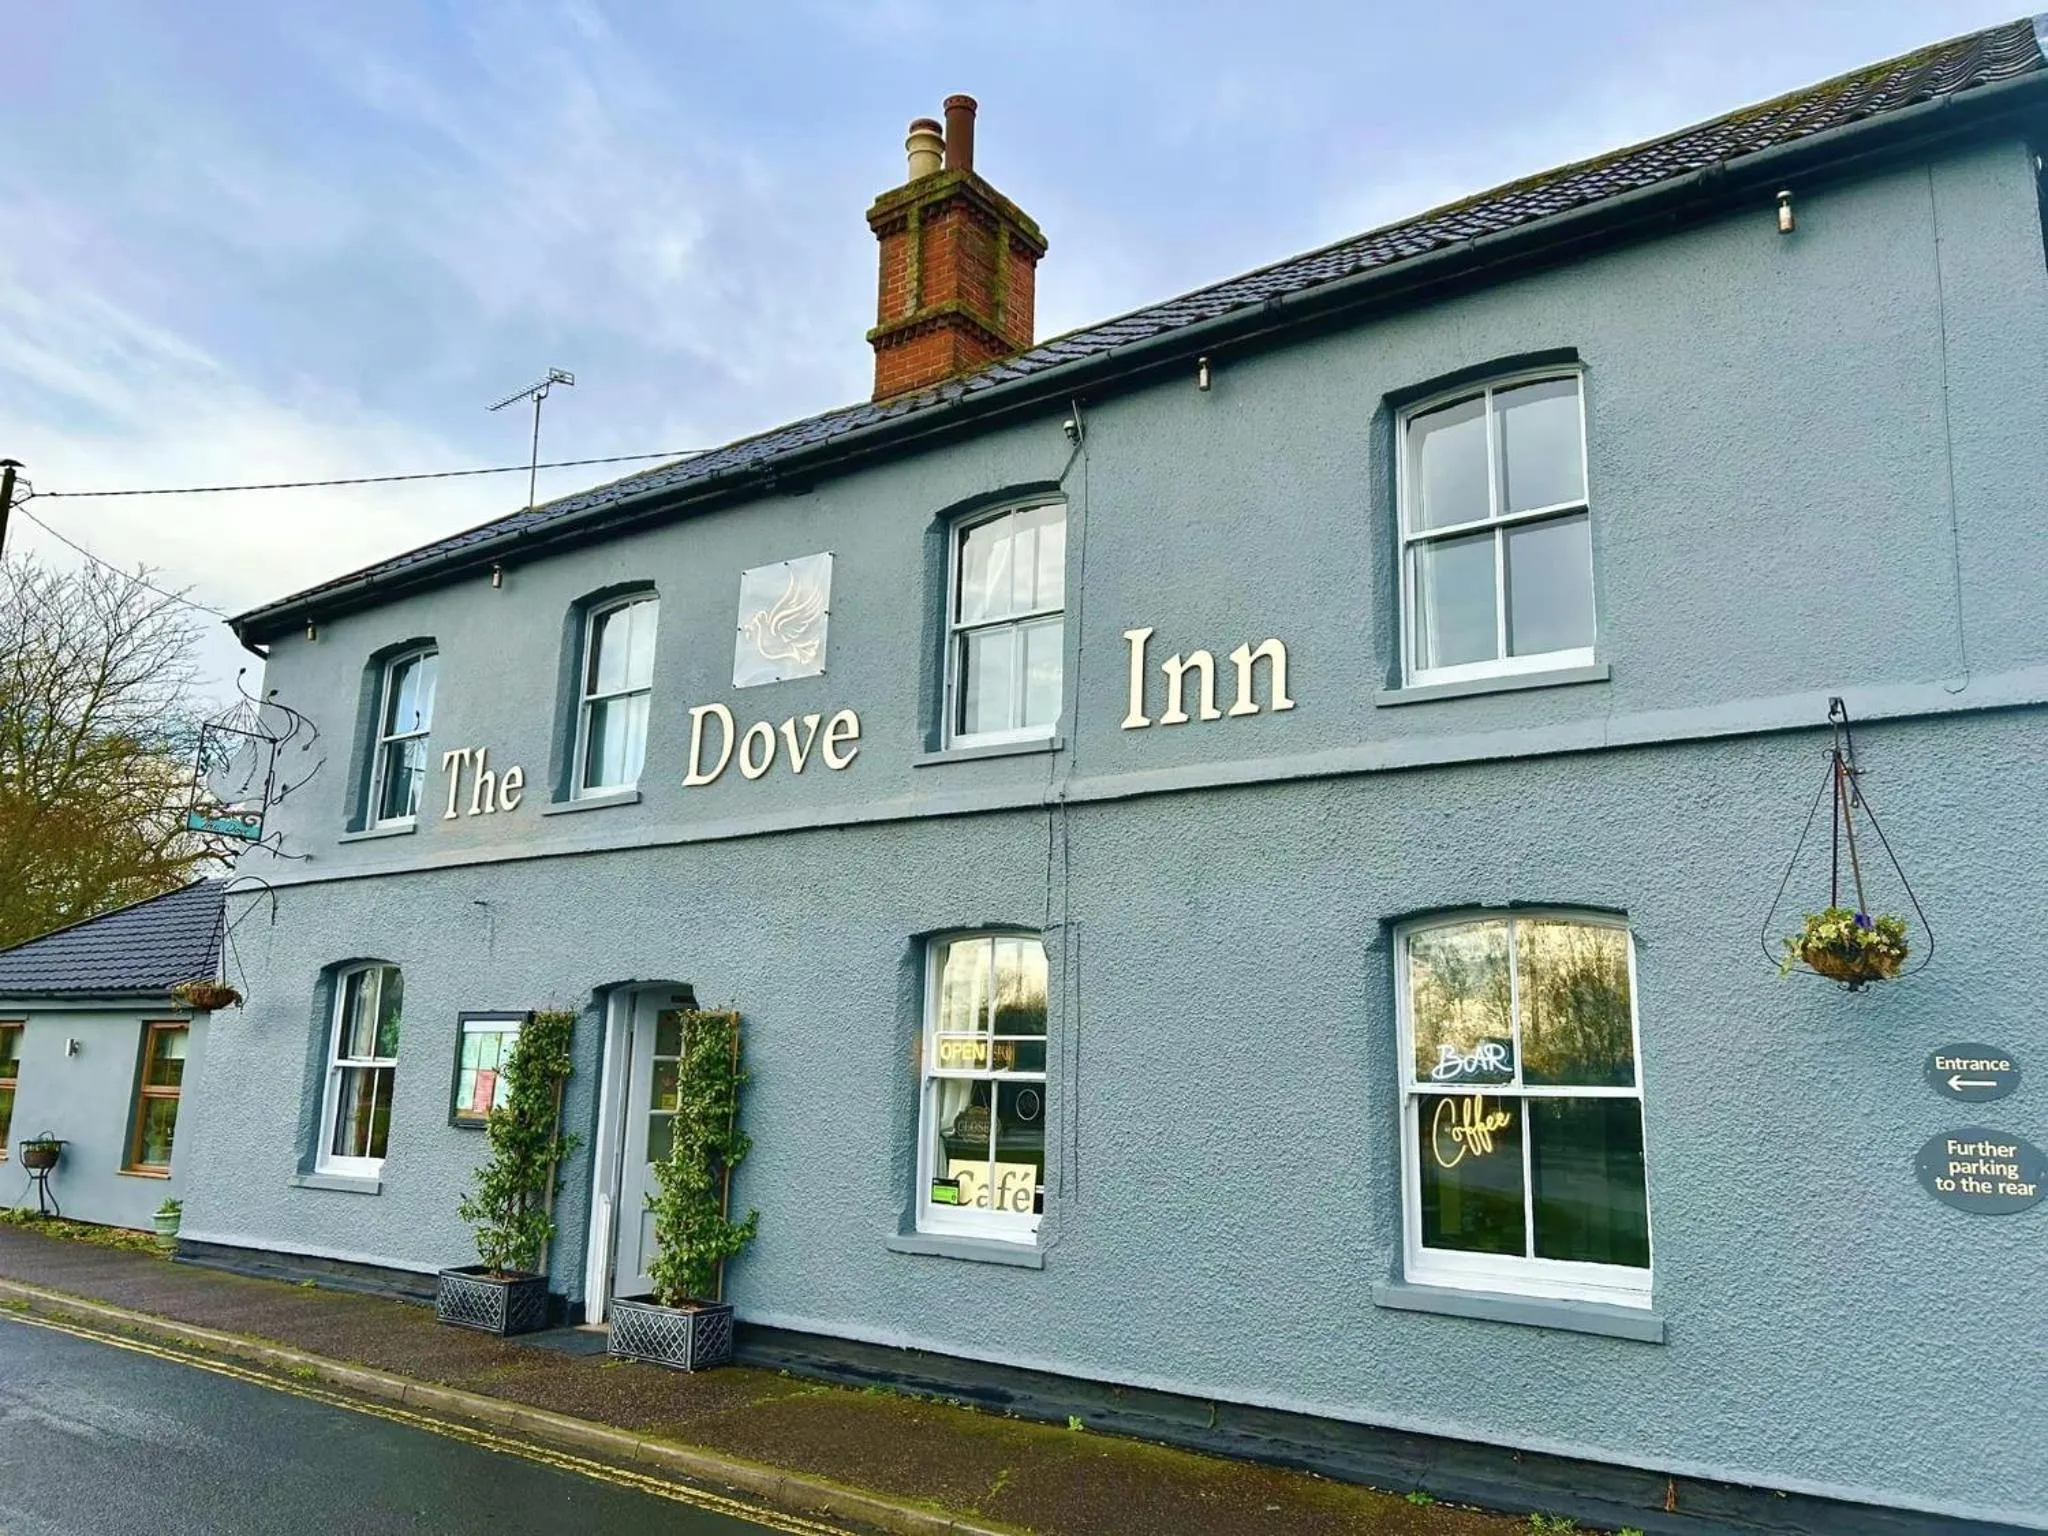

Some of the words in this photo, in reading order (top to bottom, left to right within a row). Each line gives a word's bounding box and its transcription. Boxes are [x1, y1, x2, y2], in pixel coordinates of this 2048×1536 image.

[442, 746, 524, 819] The
[682, 703, 860, 786] Dove
[1120, 627, 1296, 729] Inn
[940, 1042, 986, 1061] OPEN
[1935, 1056, 2010, 1071] Entrance
[957, 1120, 992, 1134] CLOSE
[1432, 1093, 1510, 1168] Coffee
[1947, 1140, 2017, 1157] Further
[1949, 1160, 2018, 1180] parking
[953, 1169, 1031, 1213] Café
[1935, 1176, 1956, 1191] to
[1960, 1177, 1993, 1194] the
[1999, 1181, 2037, 1197] rear
